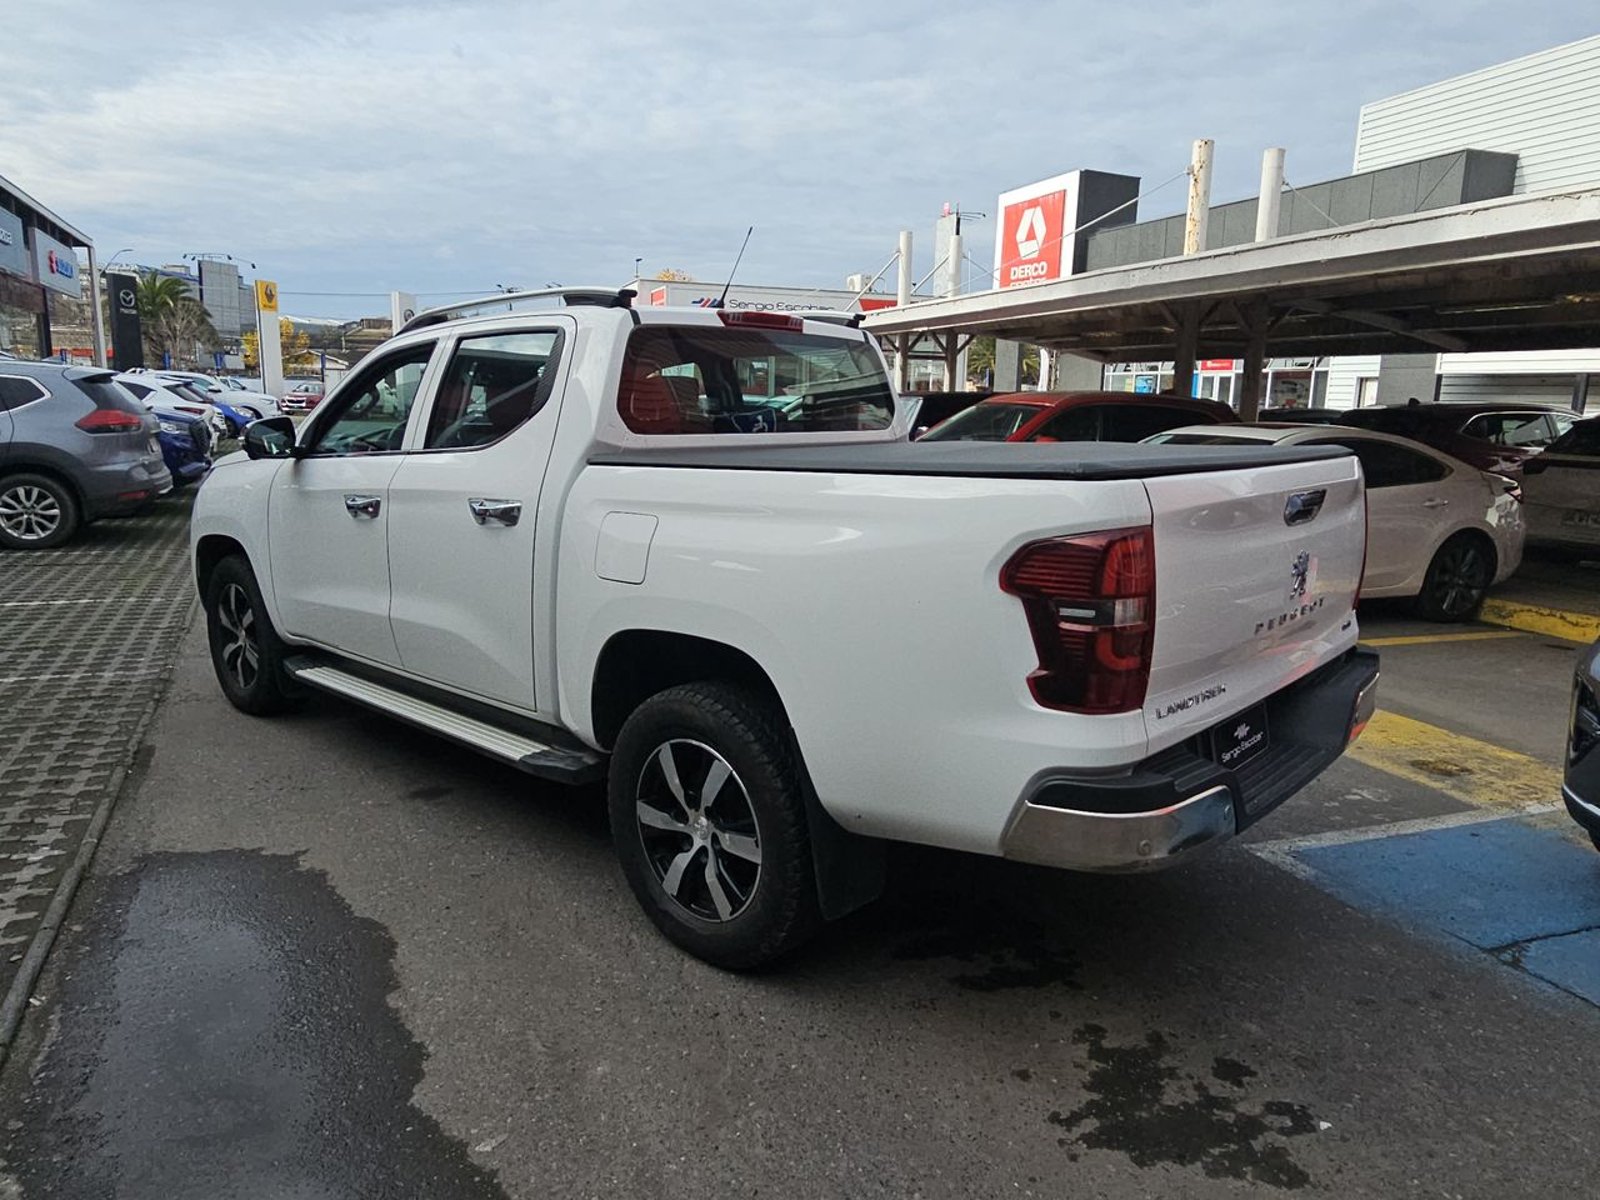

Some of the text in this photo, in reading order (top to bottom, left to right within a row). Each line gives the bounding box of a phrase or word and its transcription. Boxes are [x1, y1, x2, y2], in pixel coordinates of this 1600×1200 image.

[1010, 261, 1048, 280] DERCO
[1254, 597, 1324, 635] PEUGEOT
[1155, 684, 1226, 720] LANDTREK
